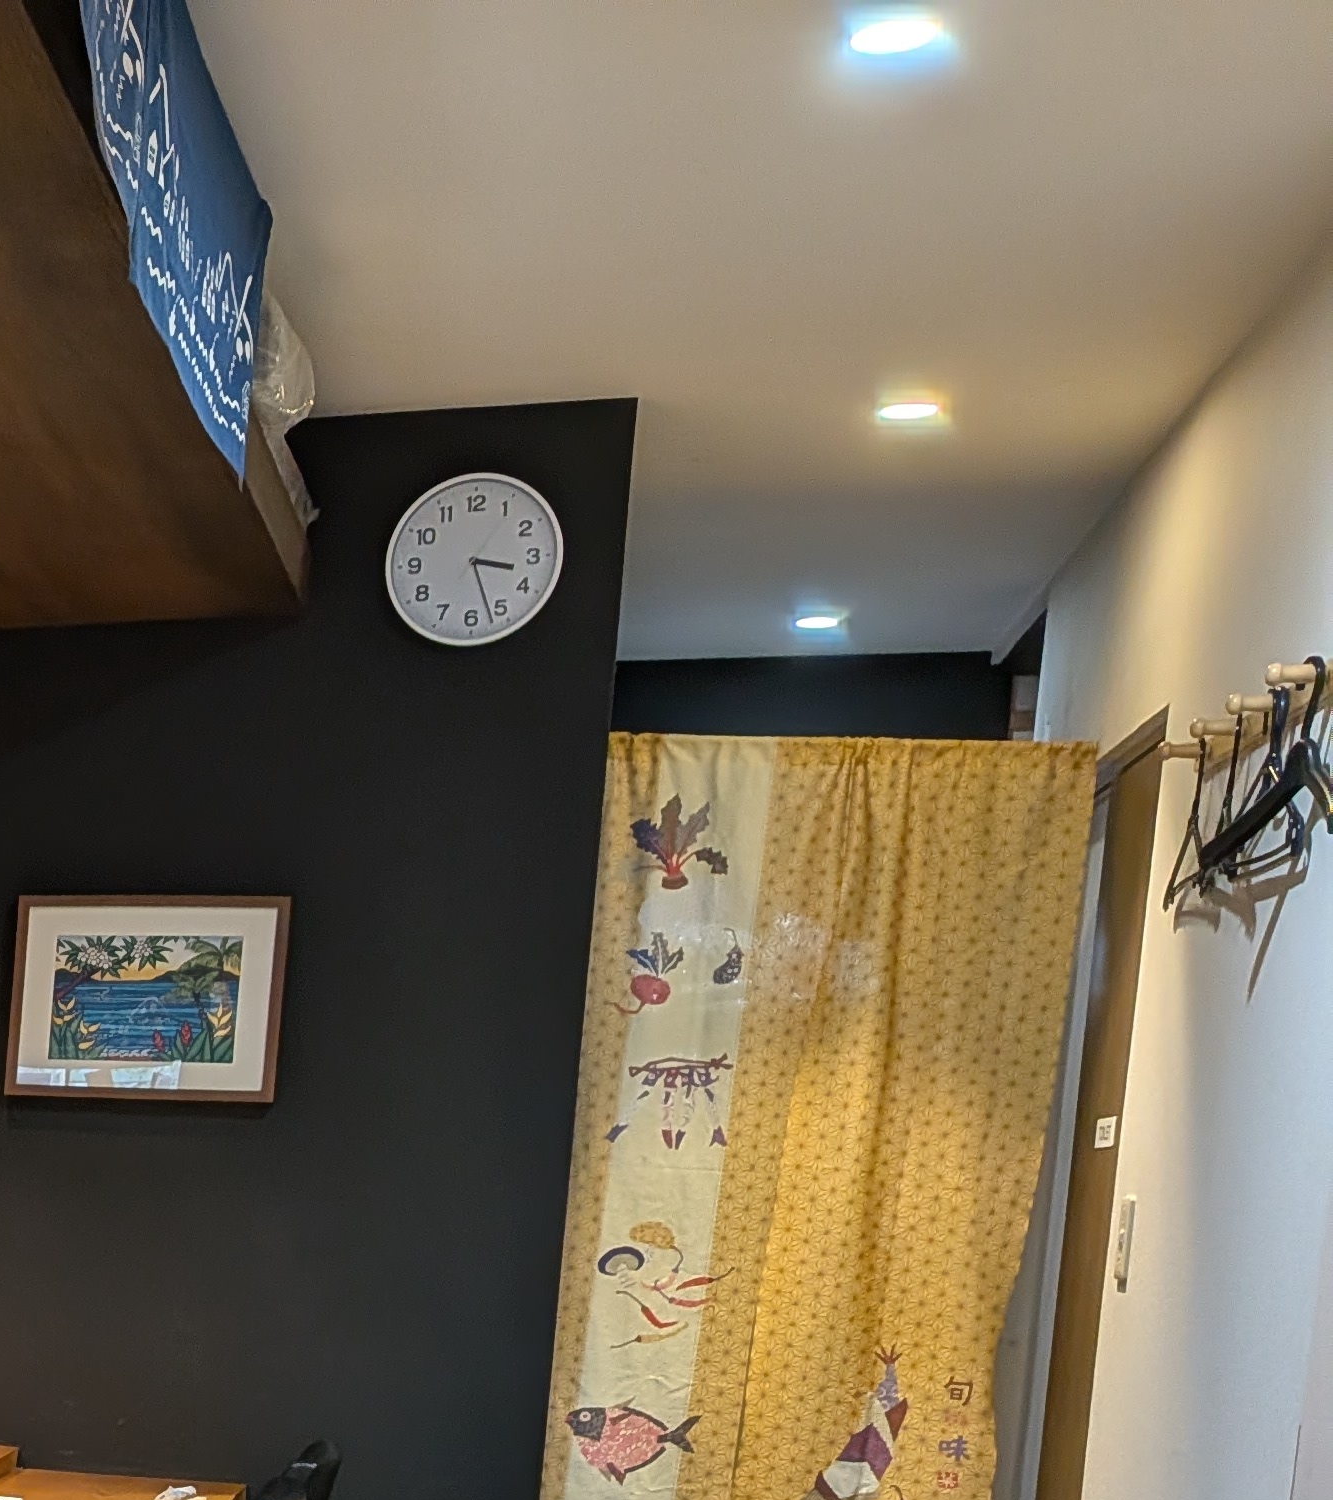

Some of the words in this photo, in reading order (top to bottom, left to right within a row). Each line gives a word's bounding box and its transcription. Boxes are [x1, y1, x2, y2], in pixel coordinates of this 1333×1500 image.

[467, 495, 486, 512] 12
[502, 501, 508, 516] 1
[440, 505, 453, 523] 11
[416, 527, 436, 546] 10
[519, 520, 533, 537] 2
[526, 548, 540, 565] 3
[407, 557, 422, 575] 9
[415, 585, 430, 602] 8
[516, 577, 530, 594] 4
[437, 604, 450, 621] 7
[494, 599, 508, 616] 5
[464, 610, 478, 627] 6
[944, 1376, 973, 1406] 旬
